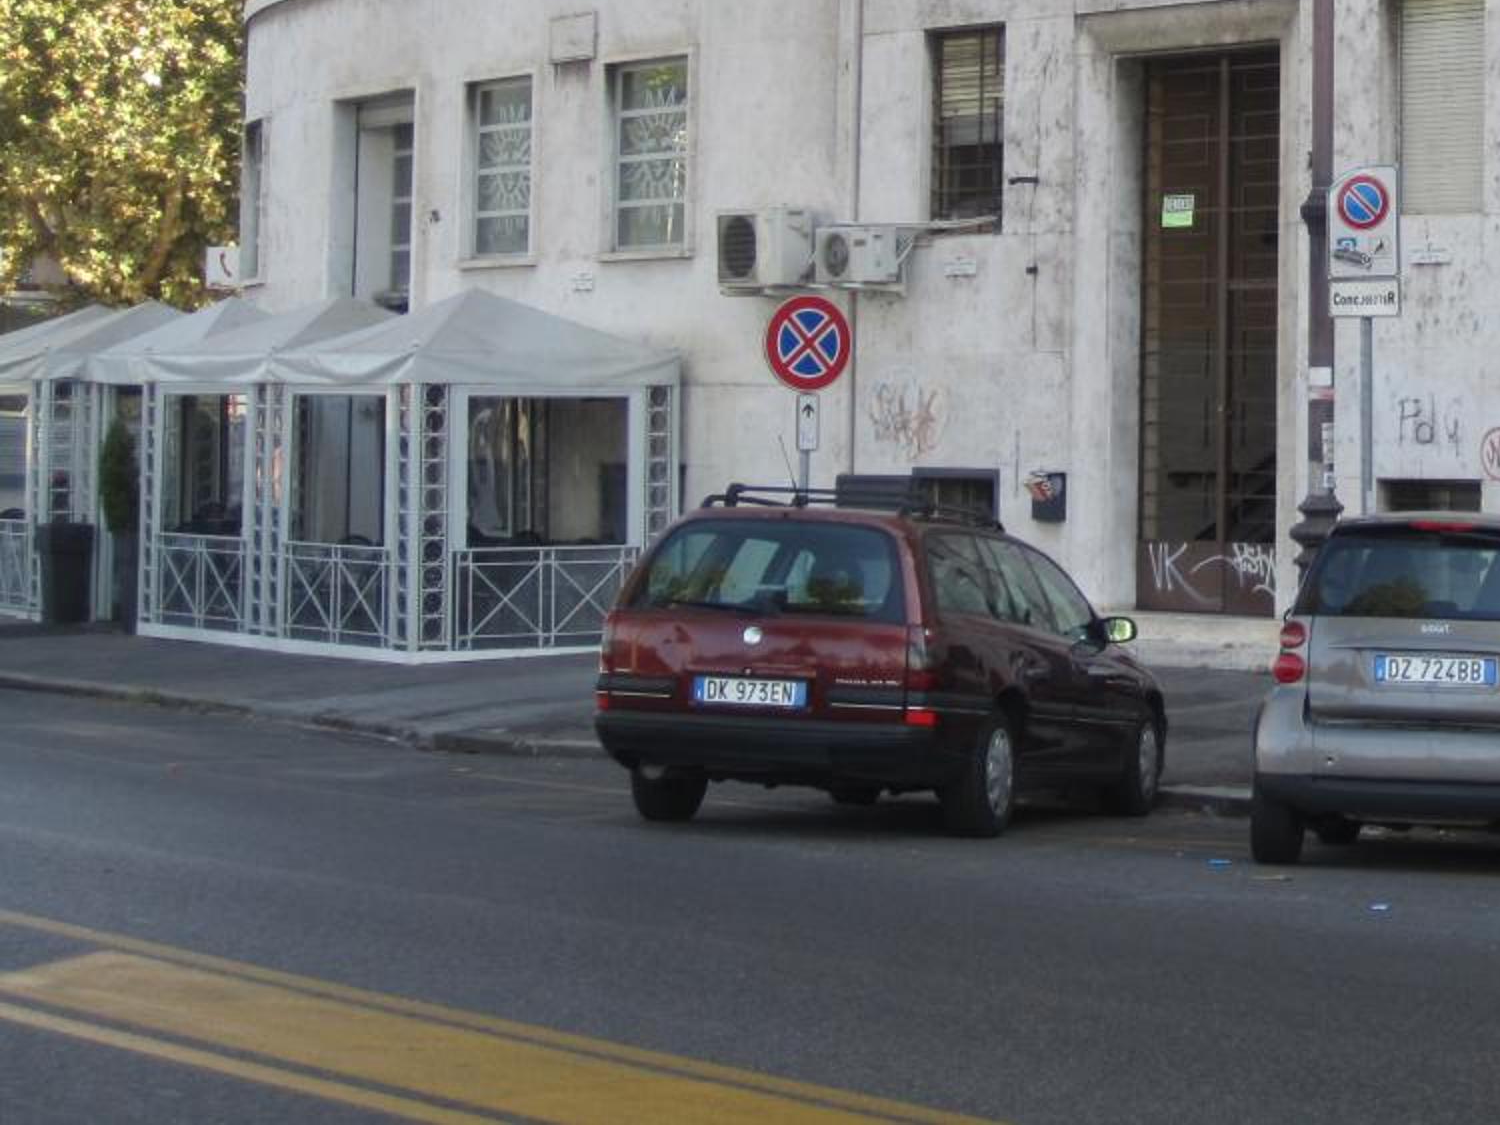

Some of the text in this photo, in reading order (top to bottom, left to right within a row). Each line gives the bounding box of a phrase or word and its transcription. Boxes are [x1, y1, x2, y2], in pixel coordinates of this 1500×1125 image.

[1388, 658, 1483, 682] DZ 724BB
[706, 680, 794, 703] DK 973EN
